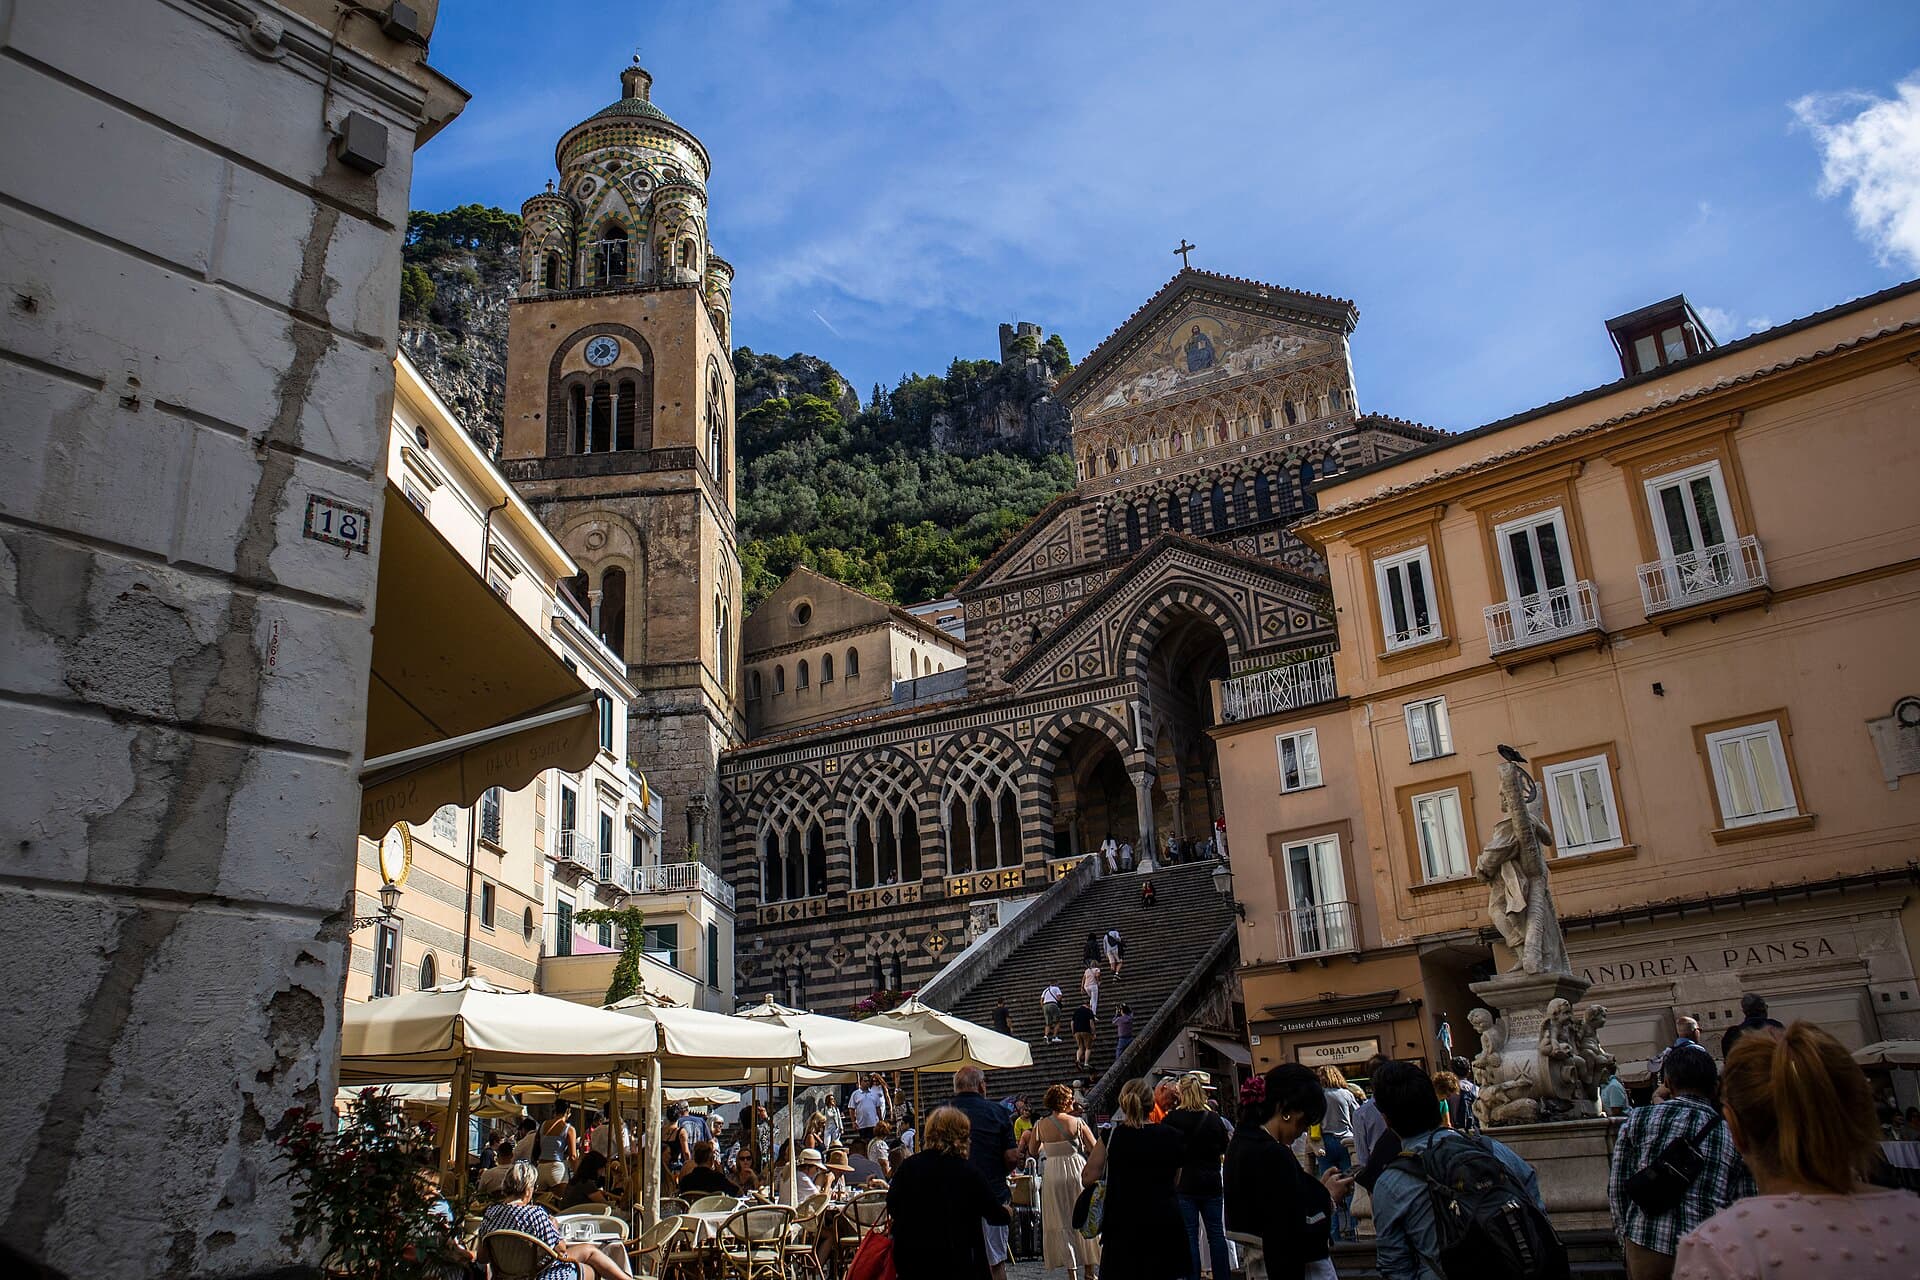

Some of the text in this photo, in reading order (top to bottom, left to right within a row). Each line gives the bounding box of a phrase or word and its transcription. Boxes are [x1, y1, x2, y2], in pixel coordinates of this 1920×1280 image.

[321, 509, 357, 540] 18
[1581, 937, 1836, 985] ANDREA PANSA
[1288, 1021, 1305, 1030] taste
[1306, 1021, 1314, 1029] of
[1315, 1018, 1341, 1028] Amalfi,
[1343, 1016, 1361, 1024] since
[1316, 1045, 1360, 1057] COBALTO
